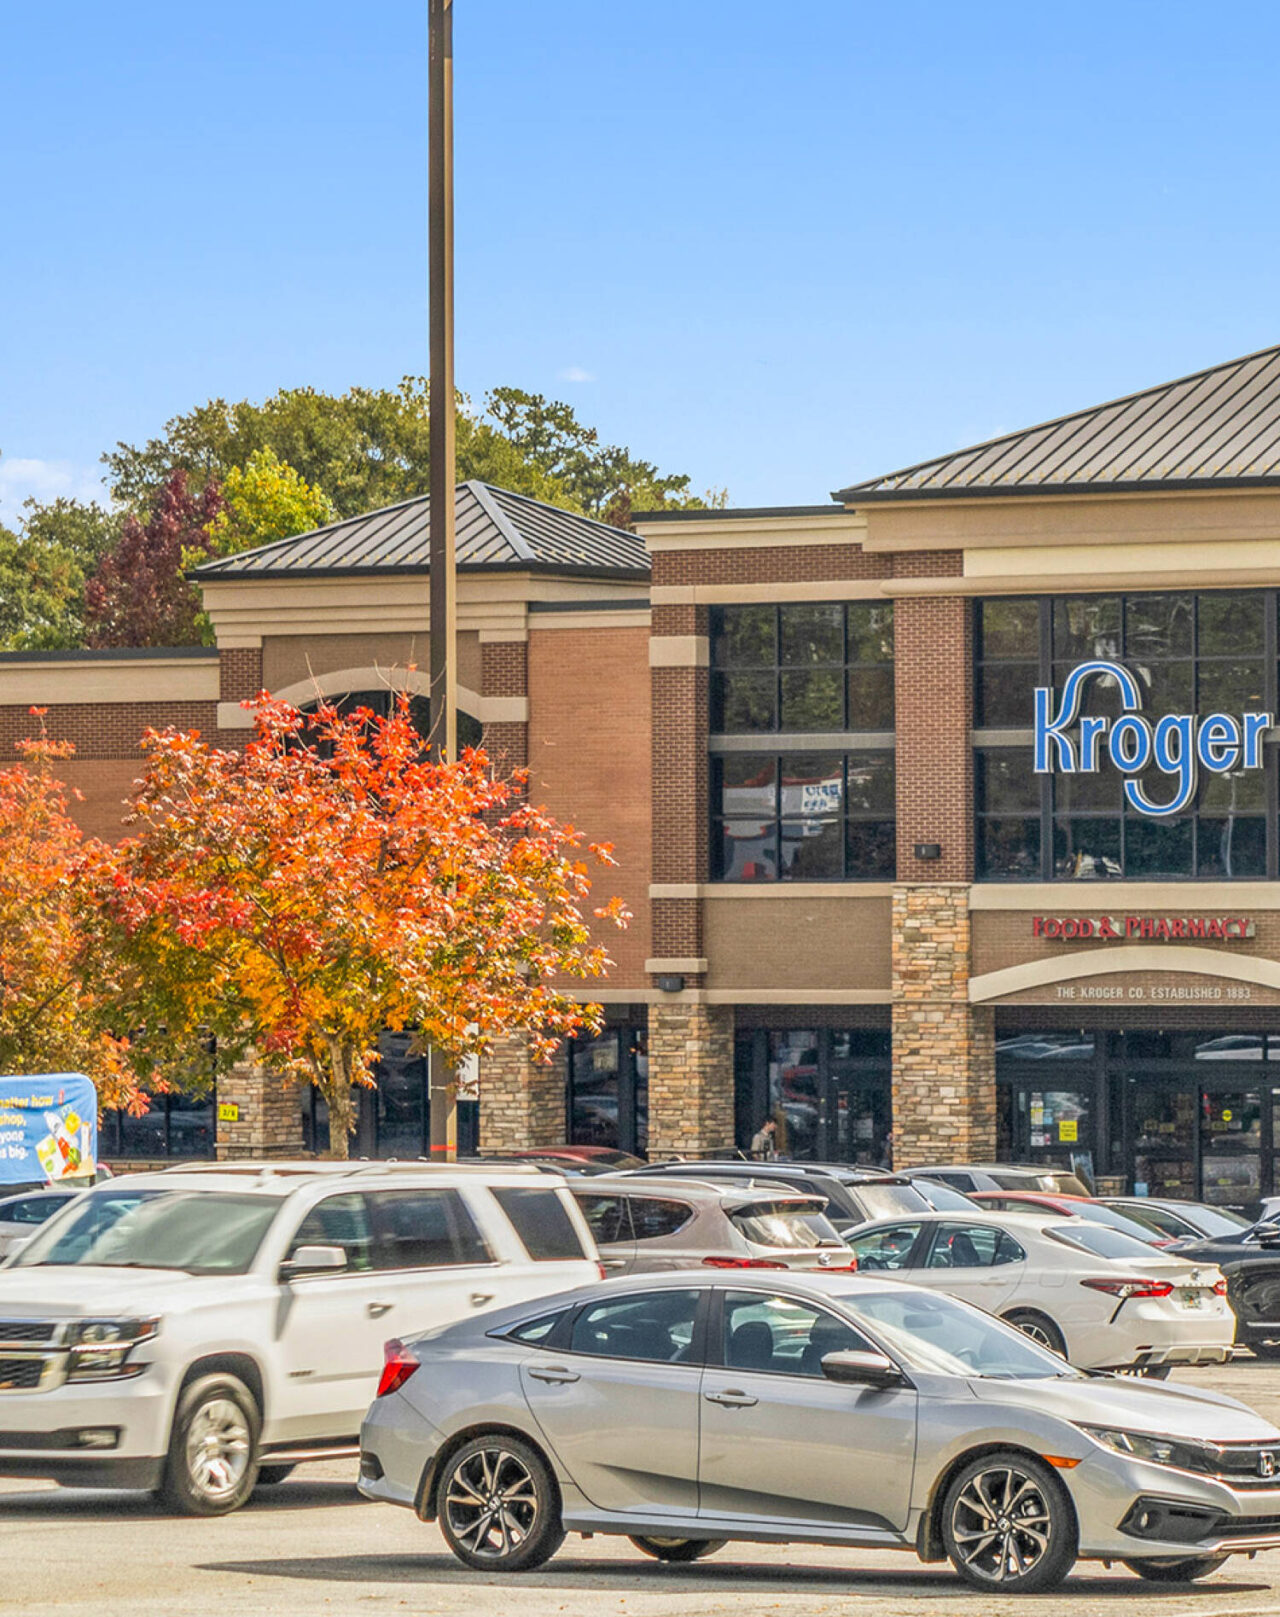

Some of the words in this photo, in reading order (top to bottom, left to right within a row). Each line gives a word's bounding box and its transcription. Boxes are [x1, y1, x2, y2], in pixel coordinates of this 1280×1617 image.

[1033, 660, 1272, 816] Kroger
[1099, 916, 1119, 938] &
[1057, 986, 1076, 999] THE
[1081, 986, 1124, 999] KROGER
[1128, 986, 1146, 999] CO.
[1151, 986, 1222, 999] ESTABLISHED
[1226, 986, 1251, 999] 1883
